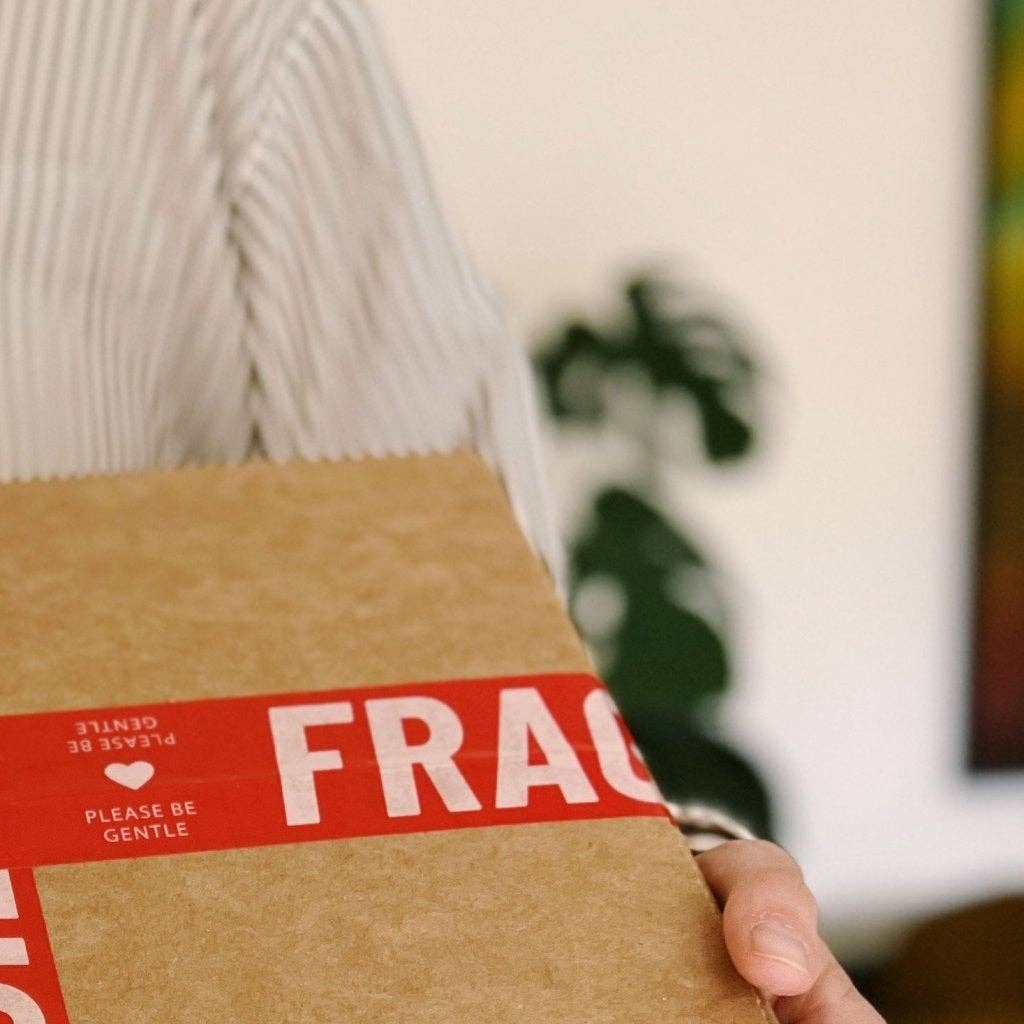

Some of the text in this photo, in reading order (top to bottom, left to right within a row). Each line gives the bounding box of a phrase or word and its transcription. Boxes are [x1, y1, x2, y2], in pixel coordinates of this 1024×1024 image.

[75, 716, 157, 735] GENTLE
[67, 732, 176, 753] PLEASE BE
[85, 801, 197, 824] PLEASE BE
[103, 822, 189, 843] GENTLE
